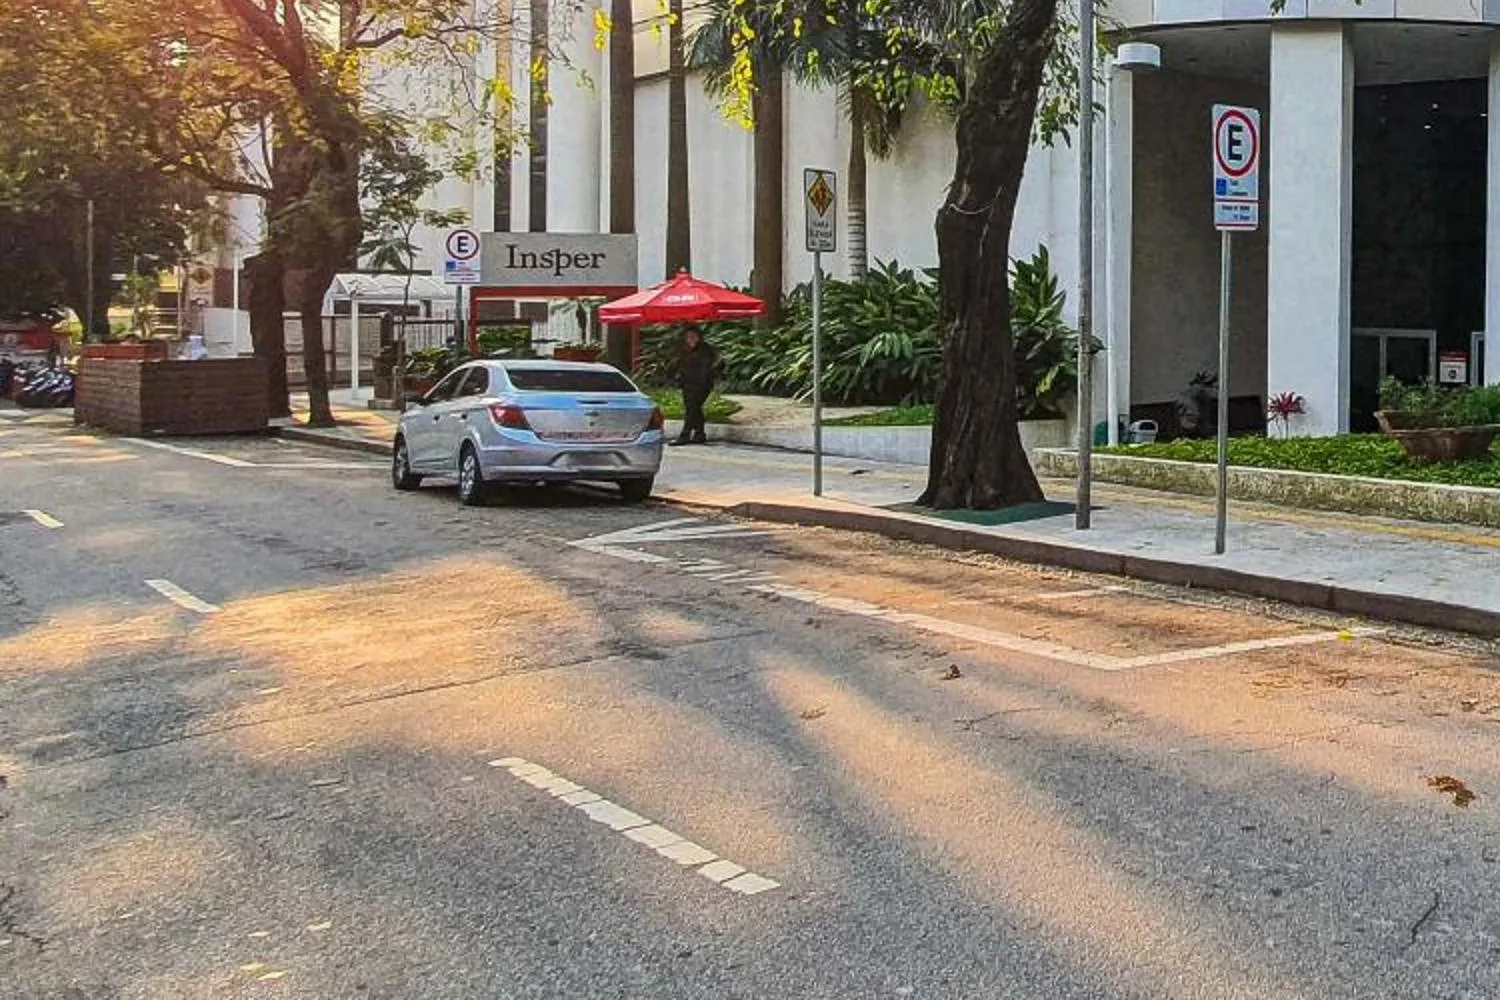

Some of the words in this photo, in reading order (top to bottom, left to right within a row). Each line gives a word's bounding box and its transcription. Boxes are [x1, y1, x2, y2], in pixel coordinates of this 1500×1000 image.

[1228, 124, 1243, 160] E
[457, 236, 469, 253] E
[505, 243, 607, 277] Insper
